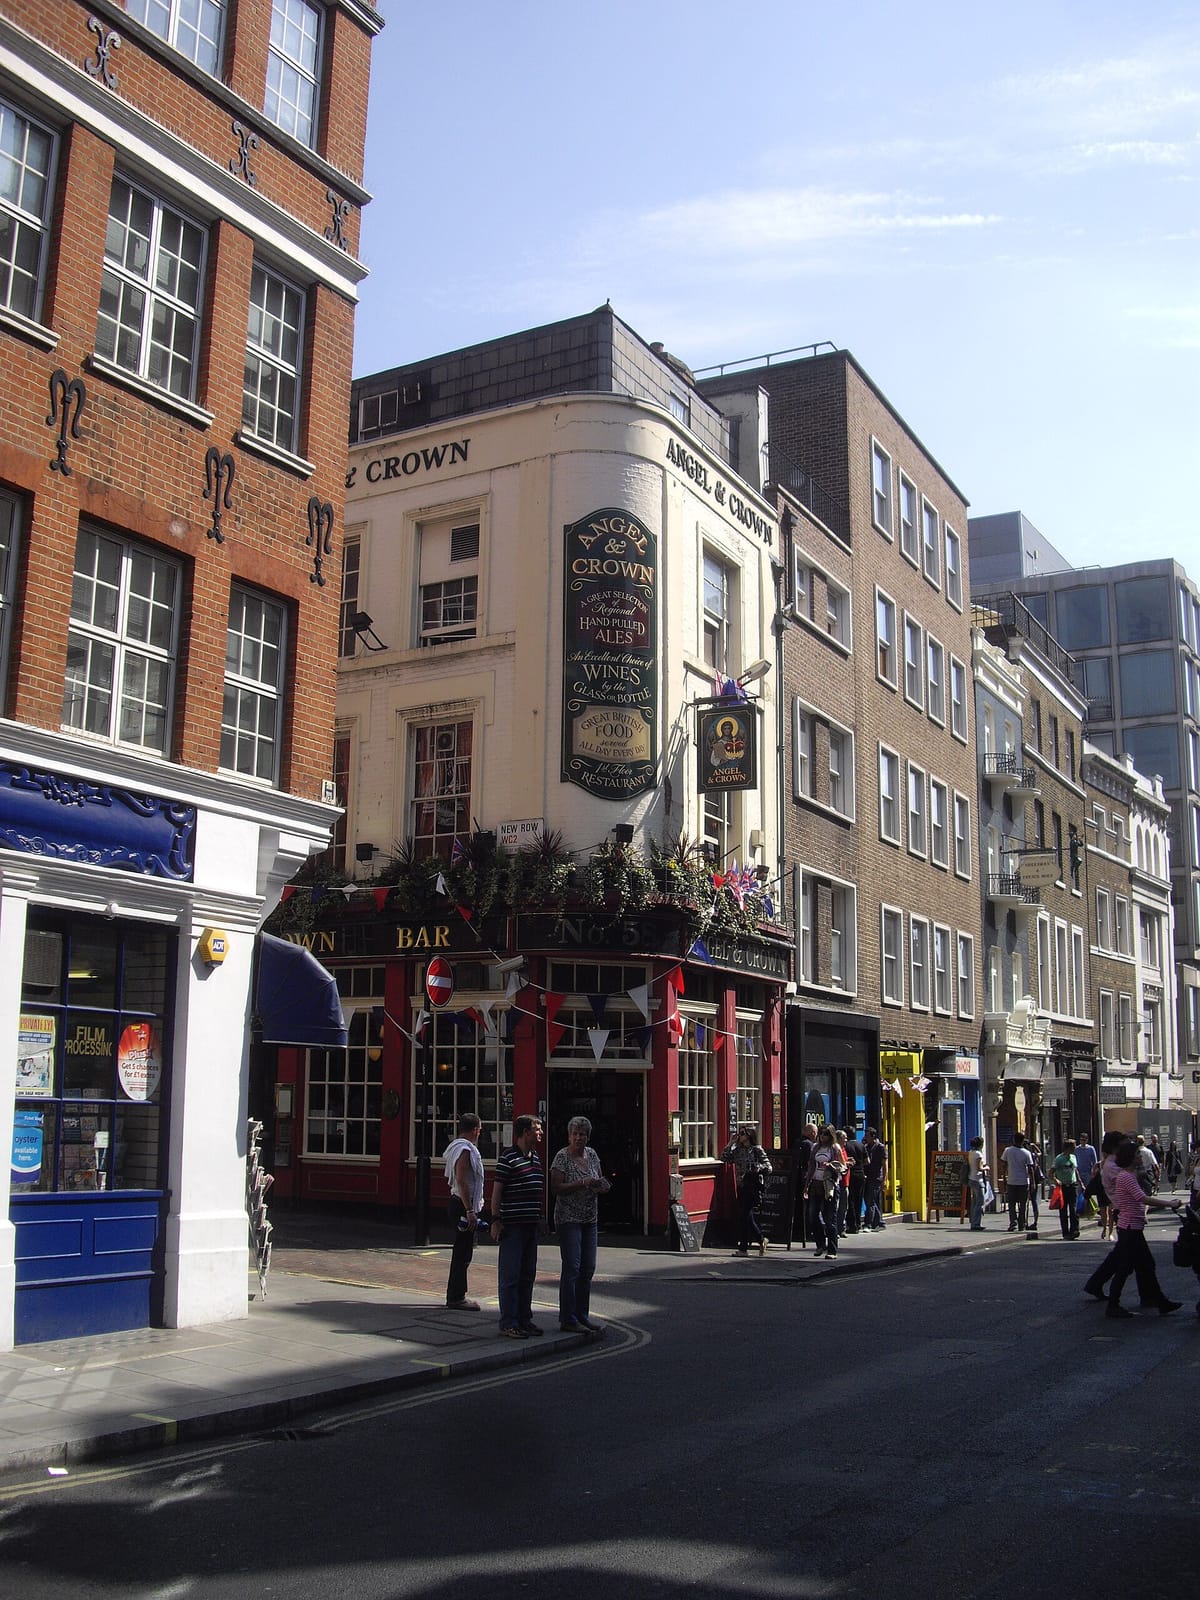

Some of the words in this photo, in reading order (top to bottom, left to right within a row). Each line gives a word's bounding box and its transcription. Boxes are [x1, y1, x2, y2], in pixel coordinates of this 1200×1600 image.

[366, 439, 471, 483] CROWN
[666, 438, 712, 494] ANGEL
[714, 480, 726, 506] &
[729, 493, 773, 547] CROWN
[578, 517, 648, 557] ANGEL
[605, 538, 627, 554] &
[572, 558, 654, 585] CROWN
[586, 591, 612, 603] GREAT
[613, 590, 649, 614] SELECTION
[591, 603, 636, 616] Regional
[595, 630, 633, 644] ALES
[567, 651, 583, 662] An
[583, 650, 620, 662] Excellent
[621, 653, 643, 667] Choice
[644, 659, 654, 671] of
[582, 664, 641, 686] WINES
[573, 681, 607, 701] GLASS
[617, 687, 652, 704] BOTTLE
[602, 681, 611, 692] by
[613, 682, 626, 692] the
[581, 711, 610, 731] GREAT
[612, 711, 645, 734] BRITISH
[595, 723, 633, 738] FOOD
[579, 740, 596, 751] ALL
[596, 745, 610, 757] DAY
[612, 747, 635, 758] EVERY
[635, 744, 646, 754] DAY
[600, 739, 628, 748] served
[608, 763, 633, 777] Floor
[713, 767, 741, 776] ANGEL
[581, 771, 646, 791] RESTAURANT
[715, 774, 746, 783] CROWN
[325, 781, 334, 800] H
[501, 824, 518, 834] NEW
[520, 822, 539, 832] ROW
[501, 835, 518, 844] WC2
[396, 925, 450, 949] BAR
[732, 944, 743, 964] &
[746, 945, 785, 974] CROWN
[76, 1025, 105, 1042] FILM
[121, 1062, 131, 1070] Get
[124, 1070, 133, 1078] for
[15, 1135, 38, 1145] oyster
[14, 1146, 38, 1154] available
